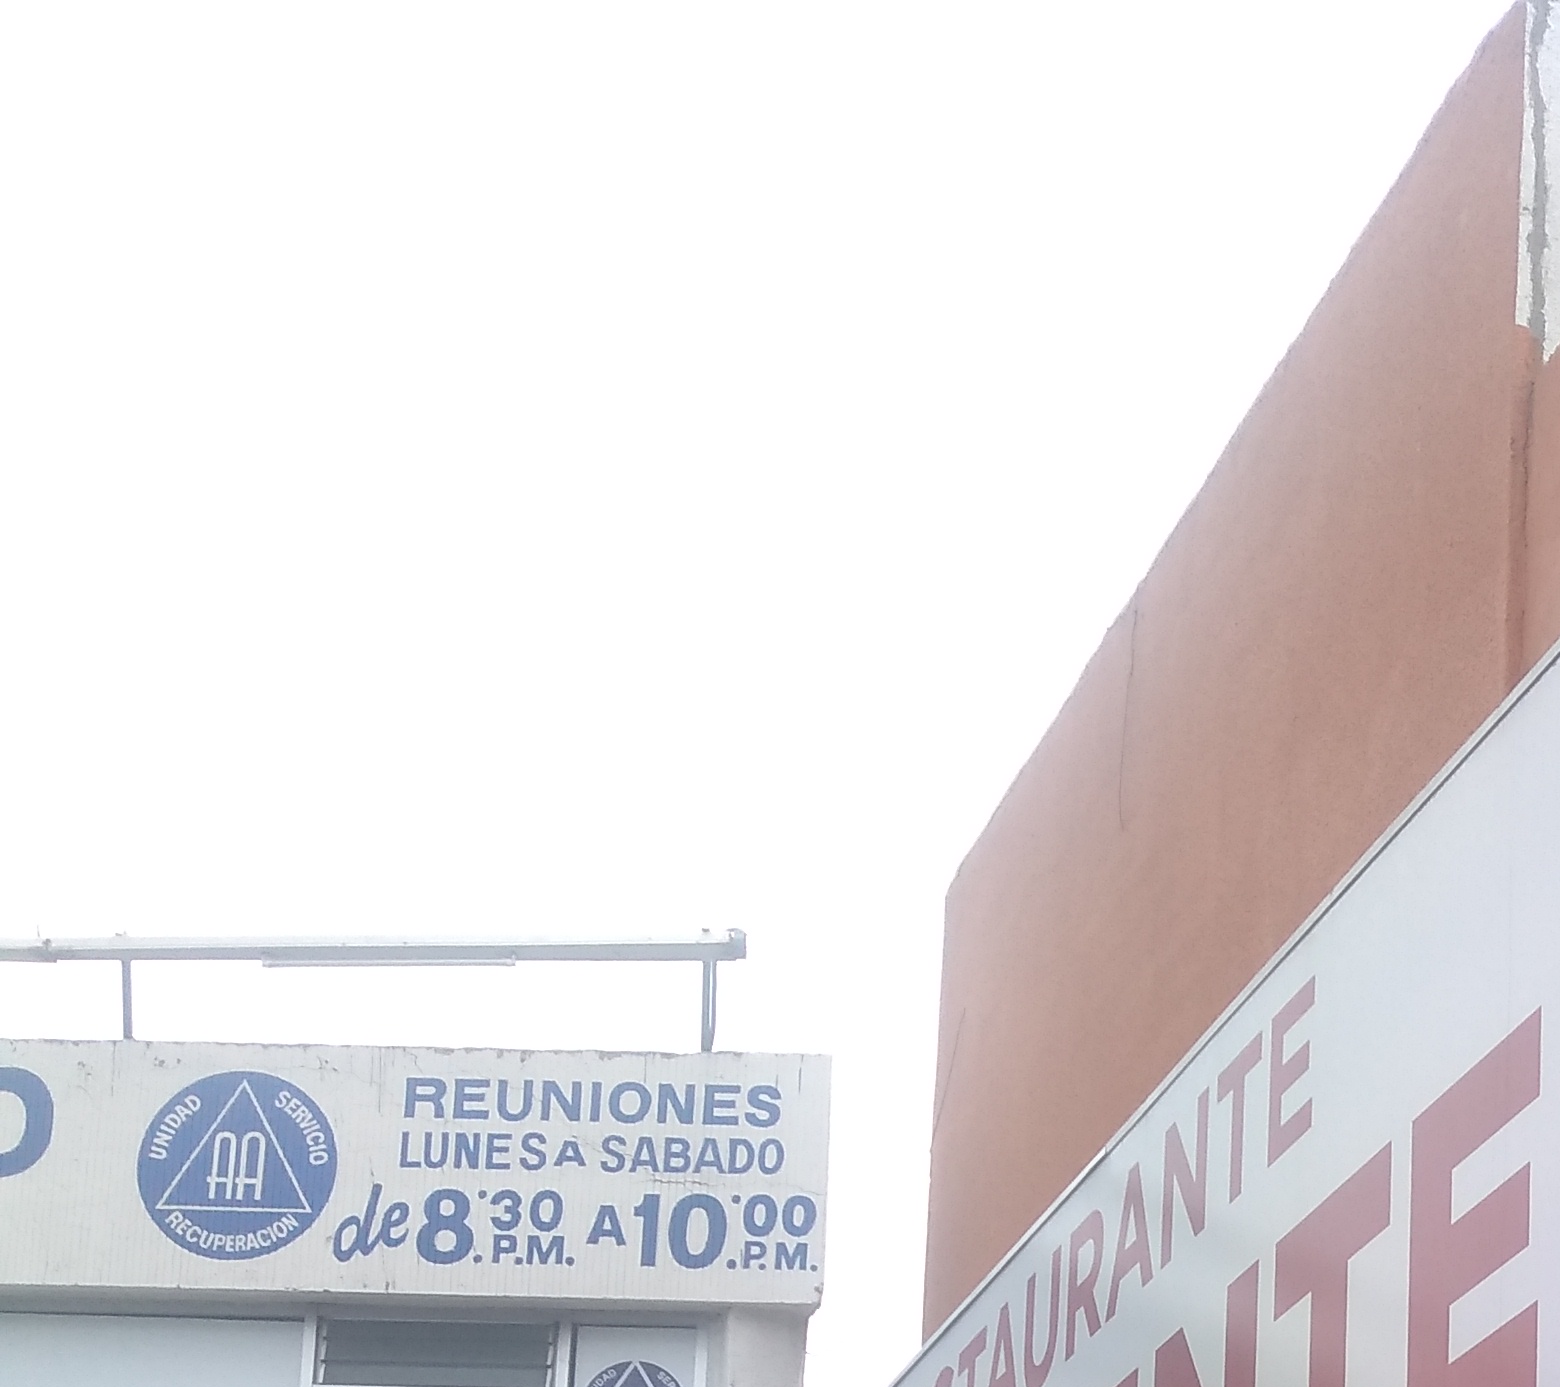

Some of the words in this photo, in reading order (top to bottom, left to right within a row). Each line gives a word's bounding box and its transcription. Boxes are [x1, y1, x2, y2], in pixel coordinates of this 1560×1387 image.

[148, 1094, 201, 1160] UNIDAD
[274, 1090, 329, 1165] SERVICIO
[403, 1077, 782, 1128] REUNIONES
[206, 1131, 266, 1201] AA
[399, 1131, 547, 1171] LUNES
[554, 1139, 587, 1167] A
[600, 1134, 785, 1175] SABADO
[164, 1211, 299, 1252] RECUPERACION
[333, 1182, 410, 1263] de
[585, 1204, 627, 1247] A
